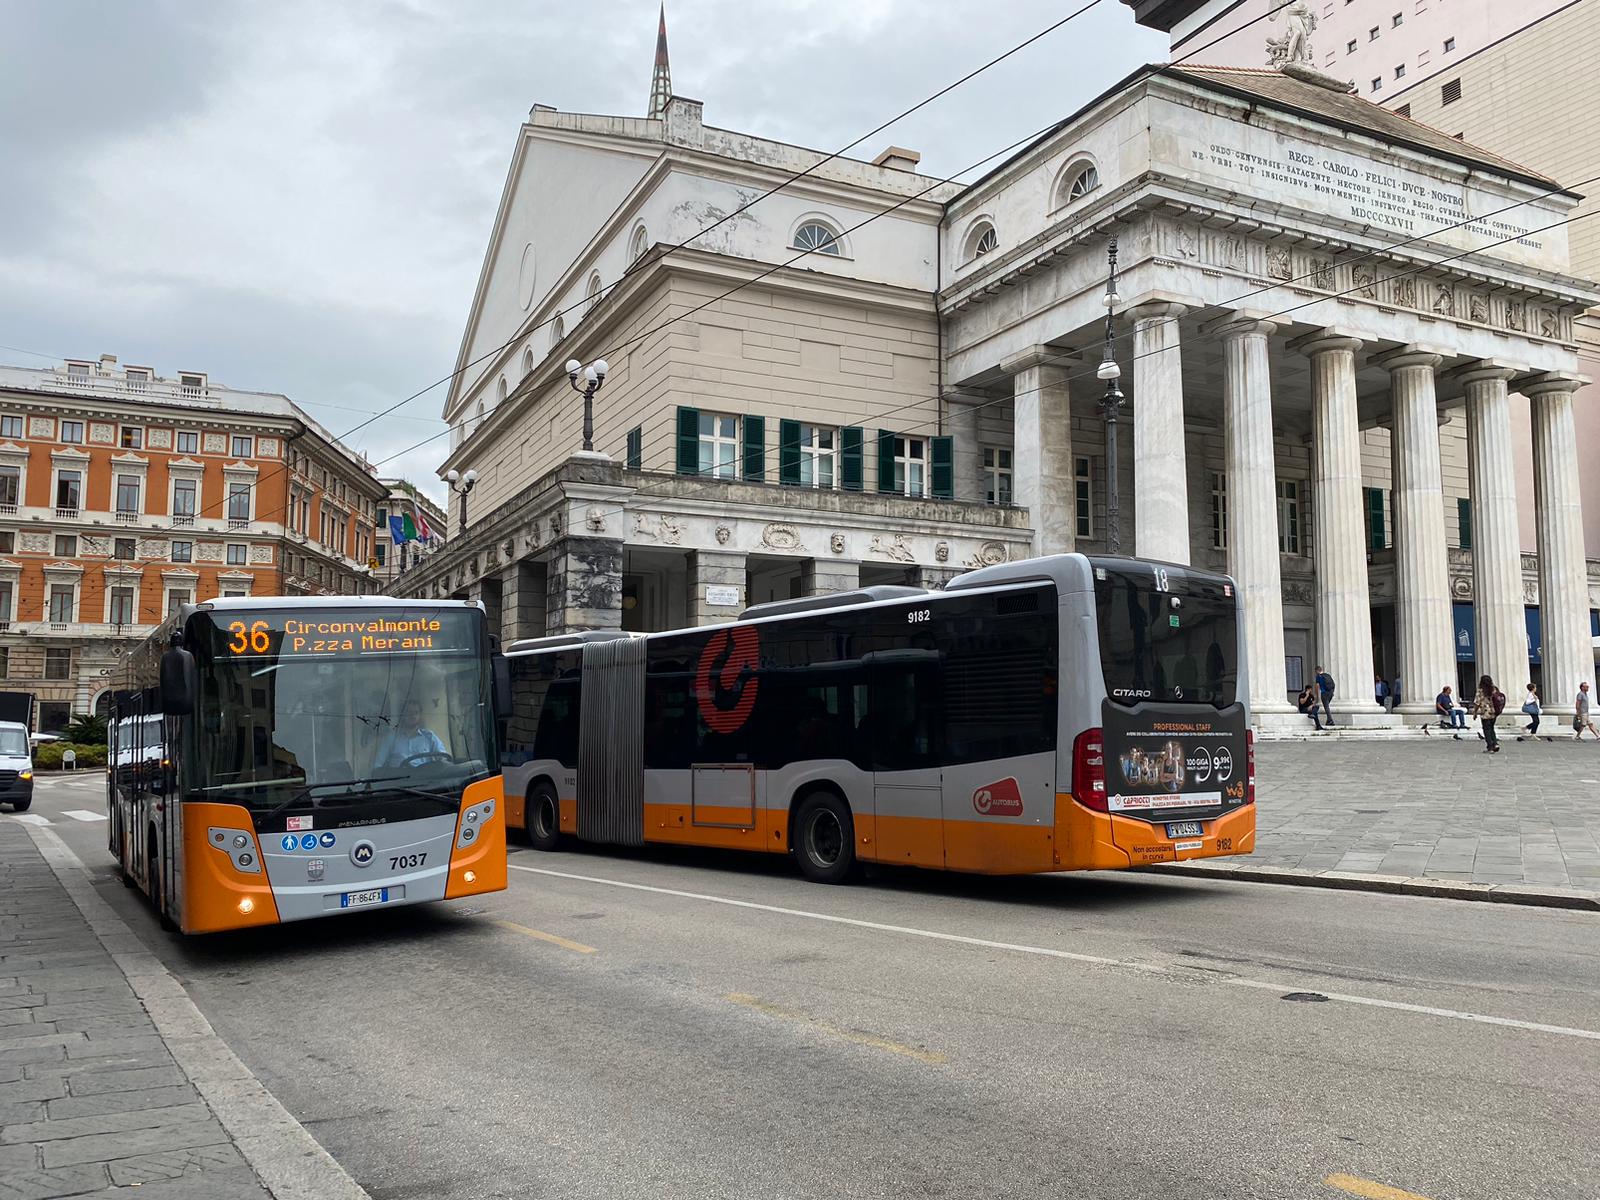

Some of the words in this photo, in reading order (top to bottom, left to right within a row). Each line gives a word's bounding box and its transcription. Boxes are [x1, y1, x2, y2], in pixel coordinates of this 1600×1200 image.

[1192, 150, 1204, 160] NE
[1210, 155, 1232, 168] VRBI
[1238, 163, 1255, 174] TOT
[1314, 183, 1366, 204] MONVMENTIS
[1322, 160, 1358, 178] CAROLO
[1365, 171, 1396, 189] FELICI
[1402, 181, 1426, 197] DVCE
[1337, 179, 1371, 194] HECTORE
[1350, 205, 1414, 231] MDCCCXXVII
[1154, 567, 1169, 592] 18
[907, 609, 931, 624] 9182
[228, 620, 270, 654] 36
[285, 617, 441, 635] Circonvalmonte
[293, 637, 353, 652] P.zza
[361, 634, 433, 650] Merani
[1113, 688, 1151, 698] CITARO
[1153, 723, 1195, 731] PROFESSIONAL
[1196, 723, 1211, 731] STAFF
[1216, 838, 1232, 851] 9182
[389, 852, 428, 870] 7037
